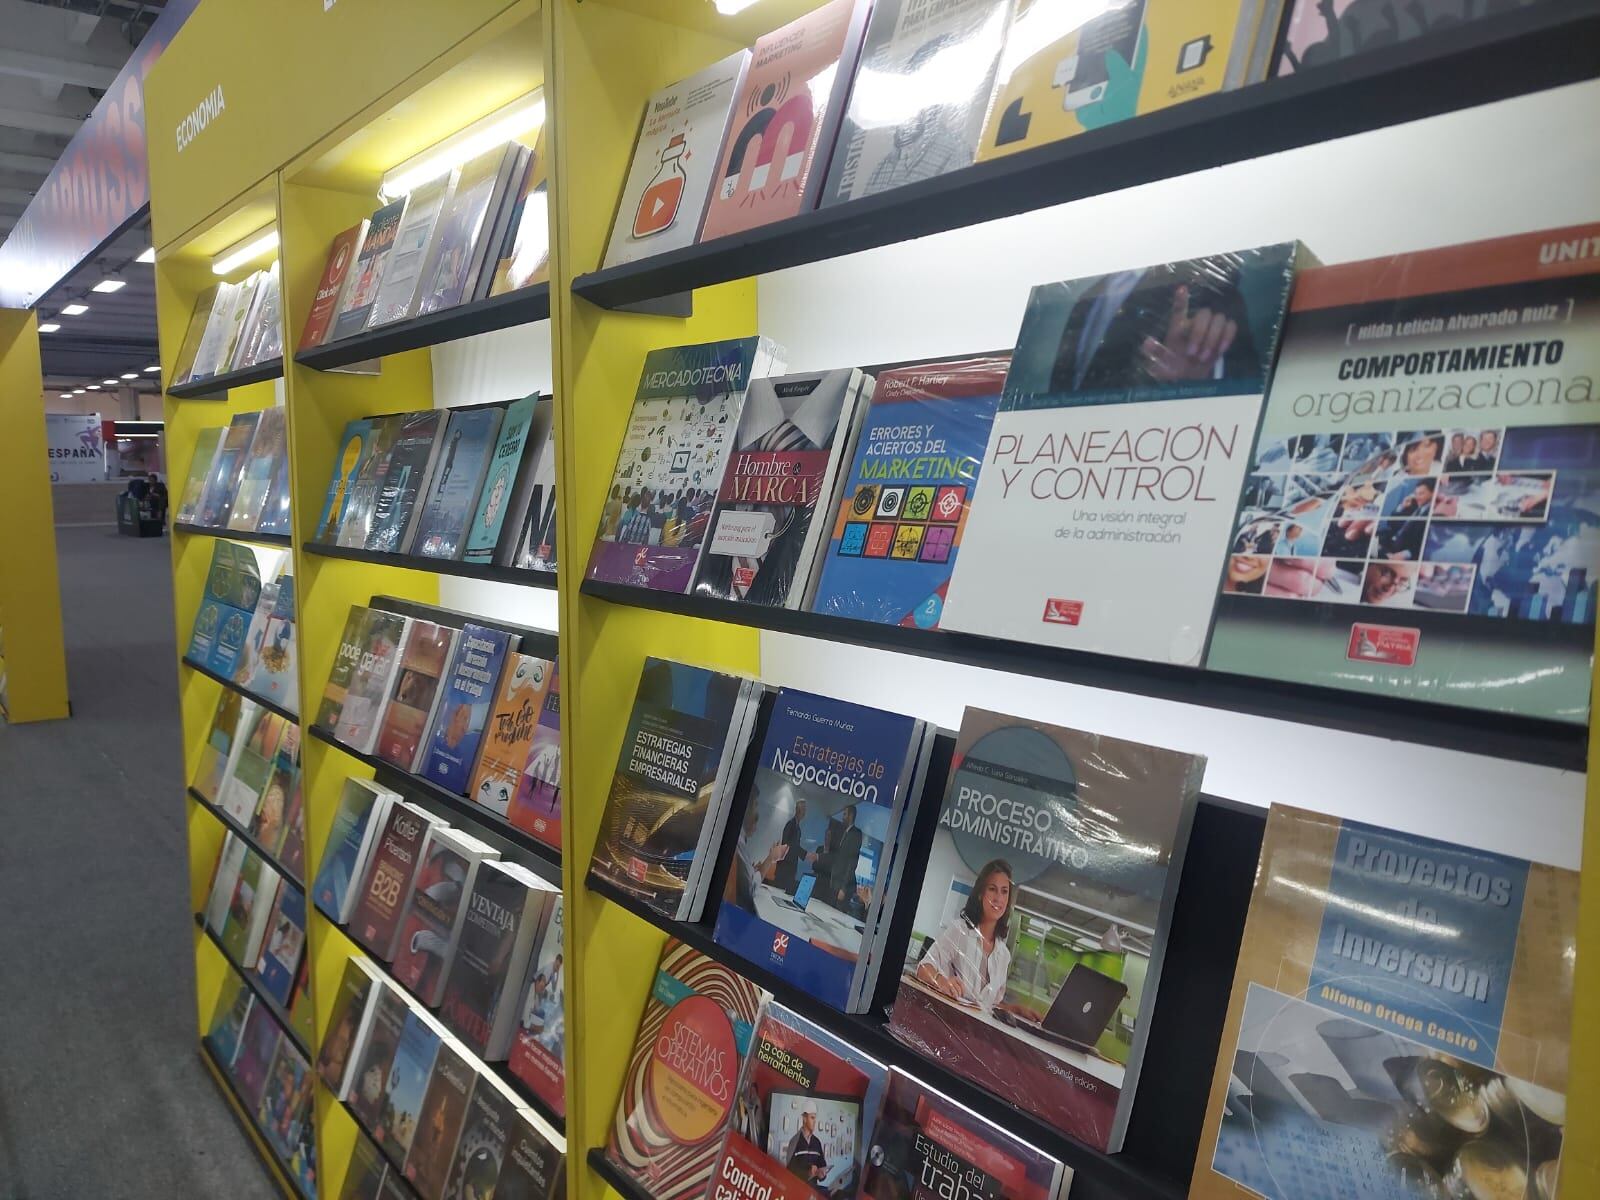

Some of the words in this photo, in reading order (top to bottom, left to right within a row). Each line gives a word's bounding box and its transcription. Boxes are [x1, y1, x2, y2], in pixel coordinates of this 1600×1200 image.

[756, 41, 802, 67] MARKETING
[176, 84, 225, 152] ECONOMIA
[1358, 323, 1392, 341] Hilda
[1396, 319, 1444, 337] Leticia
[1447, 310, 1518, 331] Alvarado
[1521, 305, 1558, 323] Ruiz
[643, 363, 742, 389] MERCADOTECNIA
[1337, 340, 1564, 380] COMPORTAMIENTO
[884, 379, 910, 390] Robert
[920, 374, 949, 386] Hartley
[1292, 374, 1600, 422] organizaciona
[866, 441, 921, 455] ACIERTOS
[924, 440, 946, 453] DEL
[870, 426, 922, 441] ERRORES
[925, 425, 934, 438] Y
[992, 423, 1239, 465] PLANEACIÓN
[48, 446, 96, 458] ESPAÑA
[736, 455, 790, 477] Hombre
[858, 456, 975, 480] MARKETING
[728, 477, 807, 503] MARCA
[1001, 468, 1023, 499] Y
[1031, 465, 1216, 501] CONTROL
[1054, 527, 1070, 539] de
[1073, 527, 1084, 540] la
[1086, 527, 1182, 543] administración
[1072, 509, 1097, 522] Una
[1100, 510, 1134, 523] visión
[1136, 511, 1187, 529] integral
[786, 707, 811, 721] Fernando
[812, 714, 833, 726] Guerra
[834, 719, 856, 732] Muñoz
[632, 746, 689, 774] FINANCIERAS
[636, 731, 693, 759] ESTRATEGIAS
[793, 736, 863, 773] Estrategias
[867, 760, 885, 779] de
[629, 759, 698, 794] EMPRESARIALES
[772, 747, 878, 803] Negociación
[957, 786, 1052, 832] PROCESO
[939, 808, 1089, 869] ADMINISTRATIVO
[370, 870, 401, 908] B2B
[1347, 836, 1513, 907] Proyectos
[472, 892, 514, 932] VENTAJA
[1332, 924, 1491, 1004] Inversión
[1321, 985, 1372, 1014] Alfonso
[1375, 1002, 1423, 1033] Ortega
[1426, 1020, 1478, 1052] Castro
[672, 1021, 725, 1073] SISTEMAS
[760, 1040, 771, 1055] La
[771, 1044, 790, 1065] caja
[791, 1055, 804, 1070] de
[658, 1036, 730, 1101] OPERATIVOS
[757, 1050, 811, 1089] herramientas
[1046, 1060, 1074, 1083] Segunda
[723, 1156, 772, 1200] Control
[915, 1134, 959, 1174] Estudio
[966, 1168, 985, 1191] del
